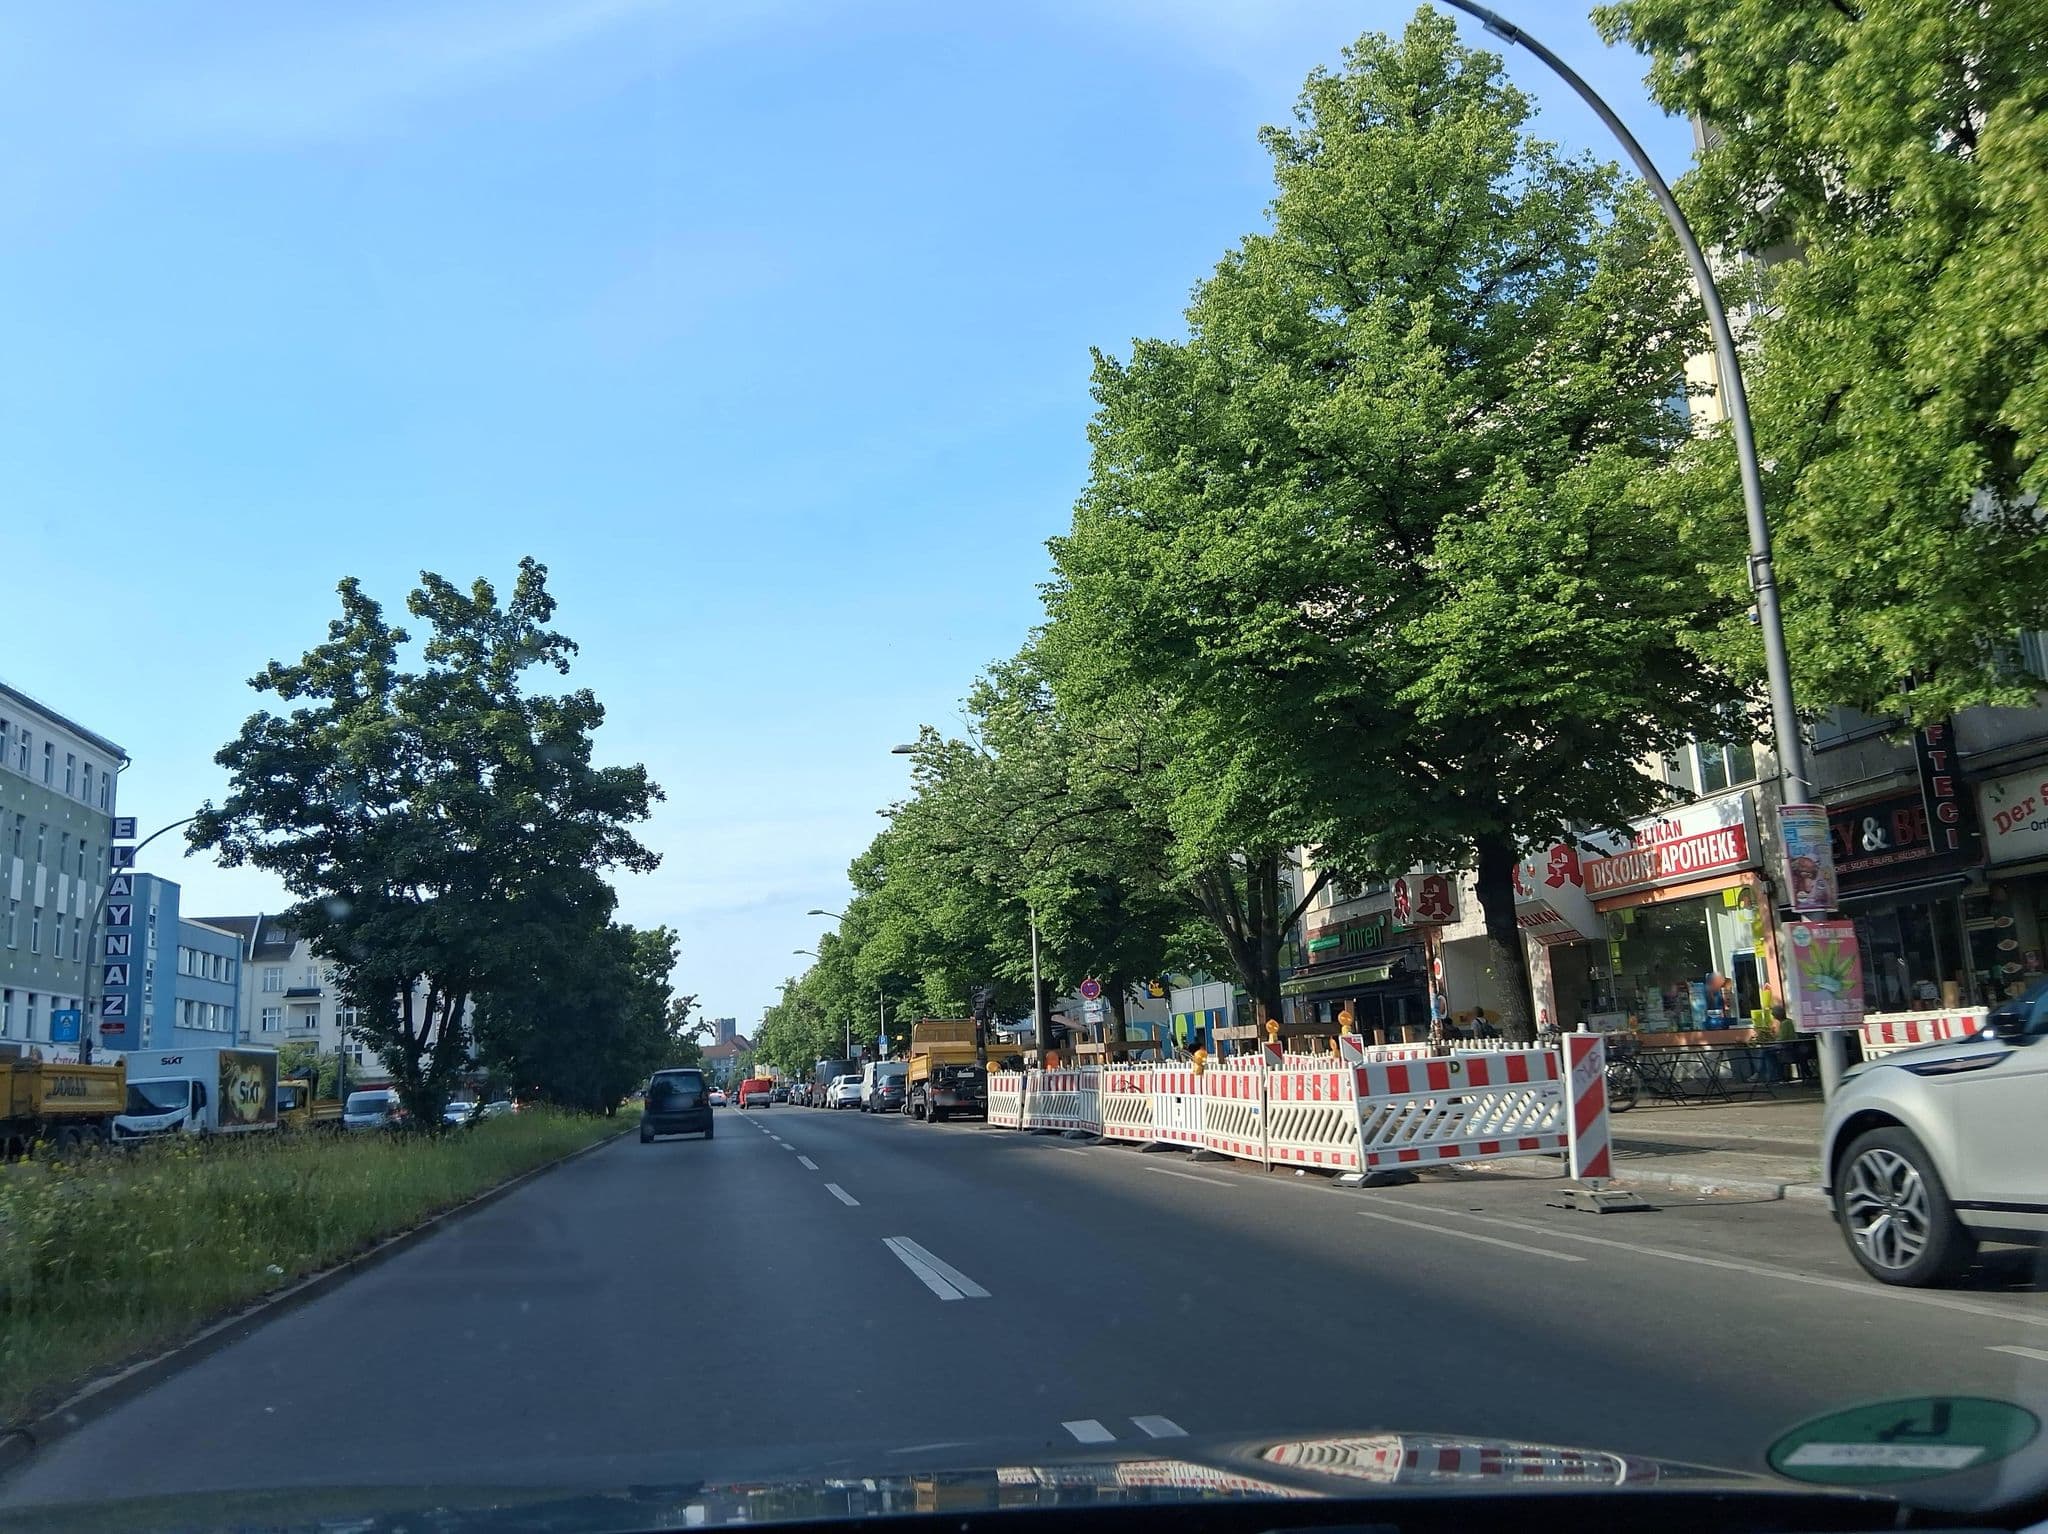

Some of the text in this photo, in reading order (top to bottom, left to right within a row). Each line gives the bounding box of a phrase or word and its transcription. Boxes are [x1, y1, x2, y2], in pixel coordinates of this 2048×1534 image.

[1862, 816, 1890, 851] &
[1993, 797, 2035, 835] Der
[1592, 831, 1738, 889] DISCOUNT APOTHEKE
[103, 819, 132, 1015] ELAYNAZ
